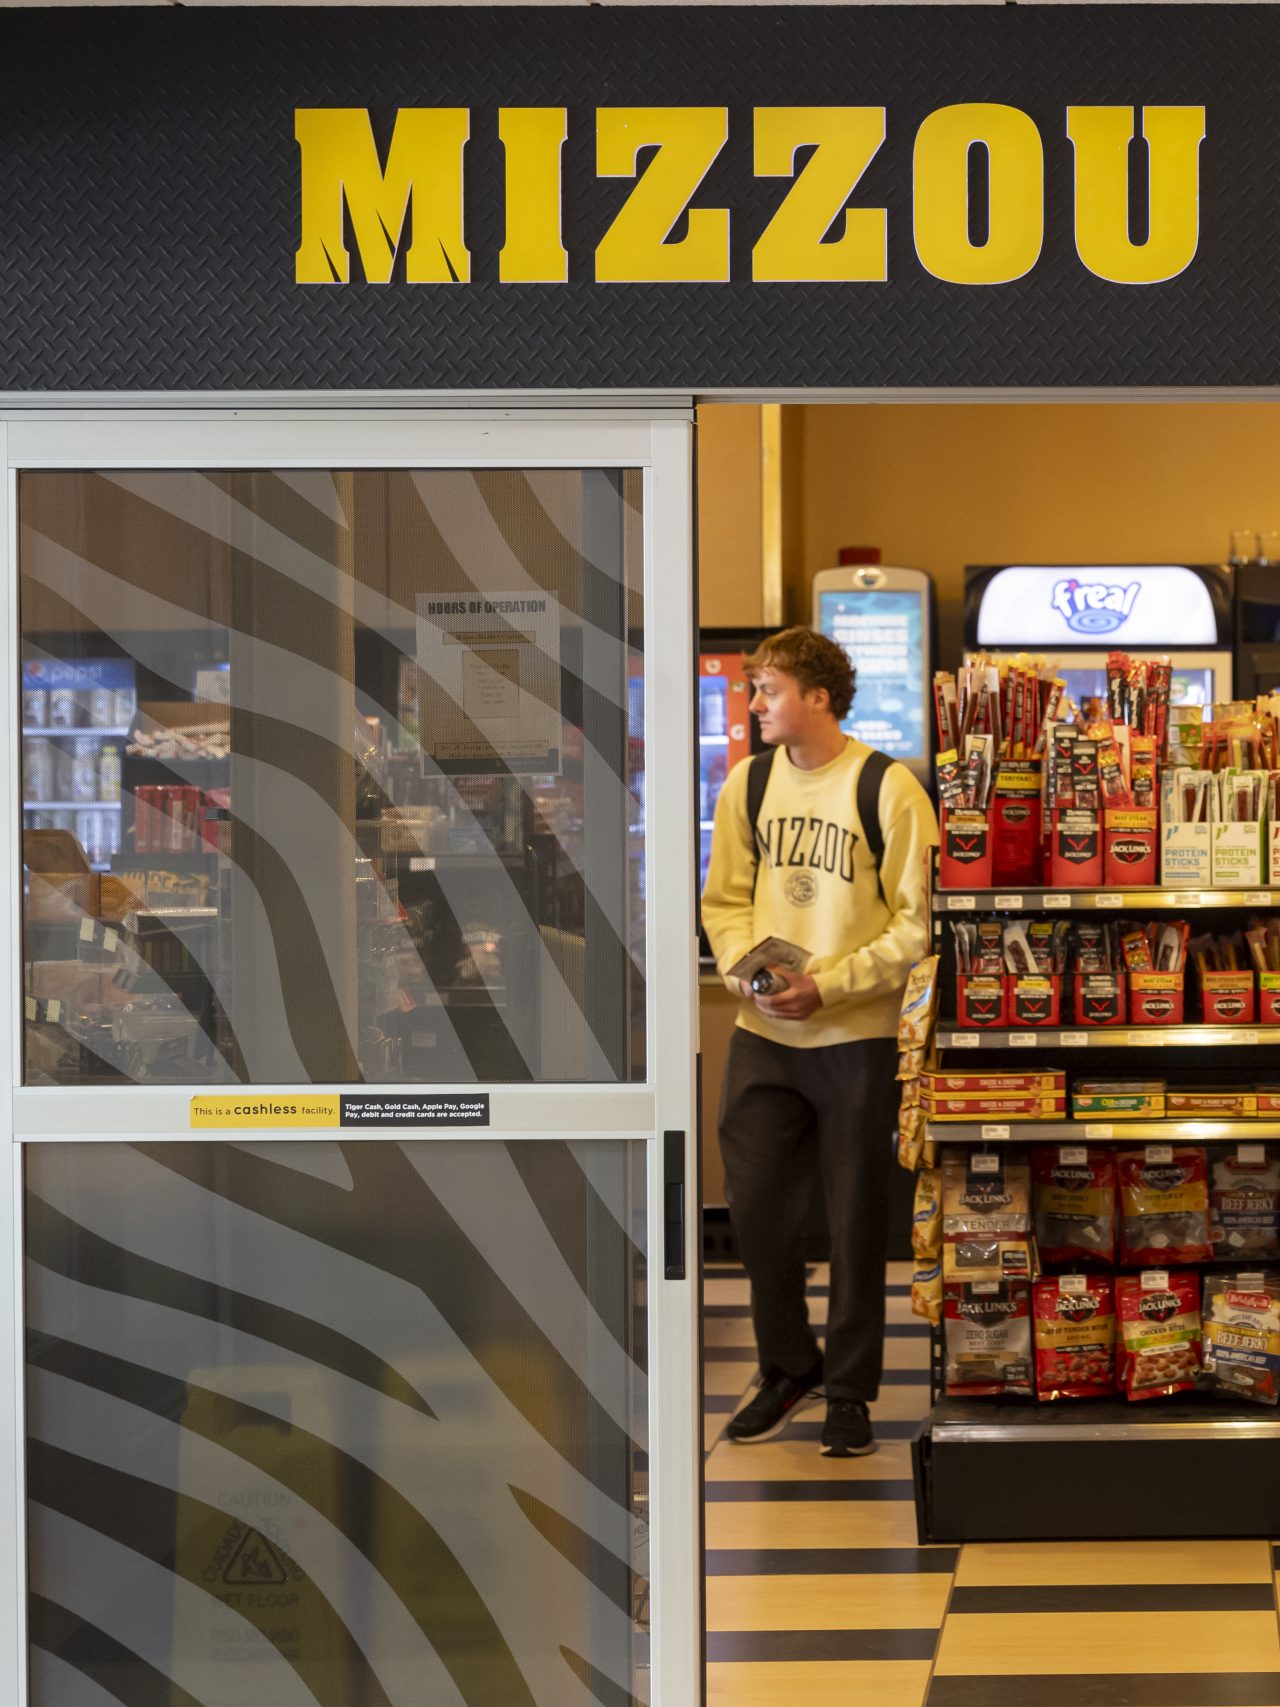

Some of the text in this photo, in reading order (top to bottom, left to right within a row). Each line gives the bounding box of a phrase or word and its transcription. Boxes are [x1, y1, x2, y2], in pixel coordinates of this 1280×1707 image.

[295, 103, 1206, 285] MIZZOU
[428, 602, 467, 615] HOURS
[1165, 849, 1208, 857] PROTEIN
[1215, 848, 1257, 857] PROTEIN
[1165, 858, 1200, 866] STICKS
[1215, 857, 1249, 865] STICKS
[194, 1107, 212, 1115] This
[216, 1107, 222, 1115] is
[234, 1103, 297, 1115] cashless
[301, 1106, 335, 1115] facility.
[1222, 1197, 1274, 1211] BEEF JERKY
[956, 1301, 984, 1313] JACK
[966, 1330, 1008, 1339] ZERO SUGAR
[1140, 1328, 1167, 1336] CHICKEN
[218, 1492, 292, 1506] CAUTION
[247, 1593, 299, 1608] FLOOR
